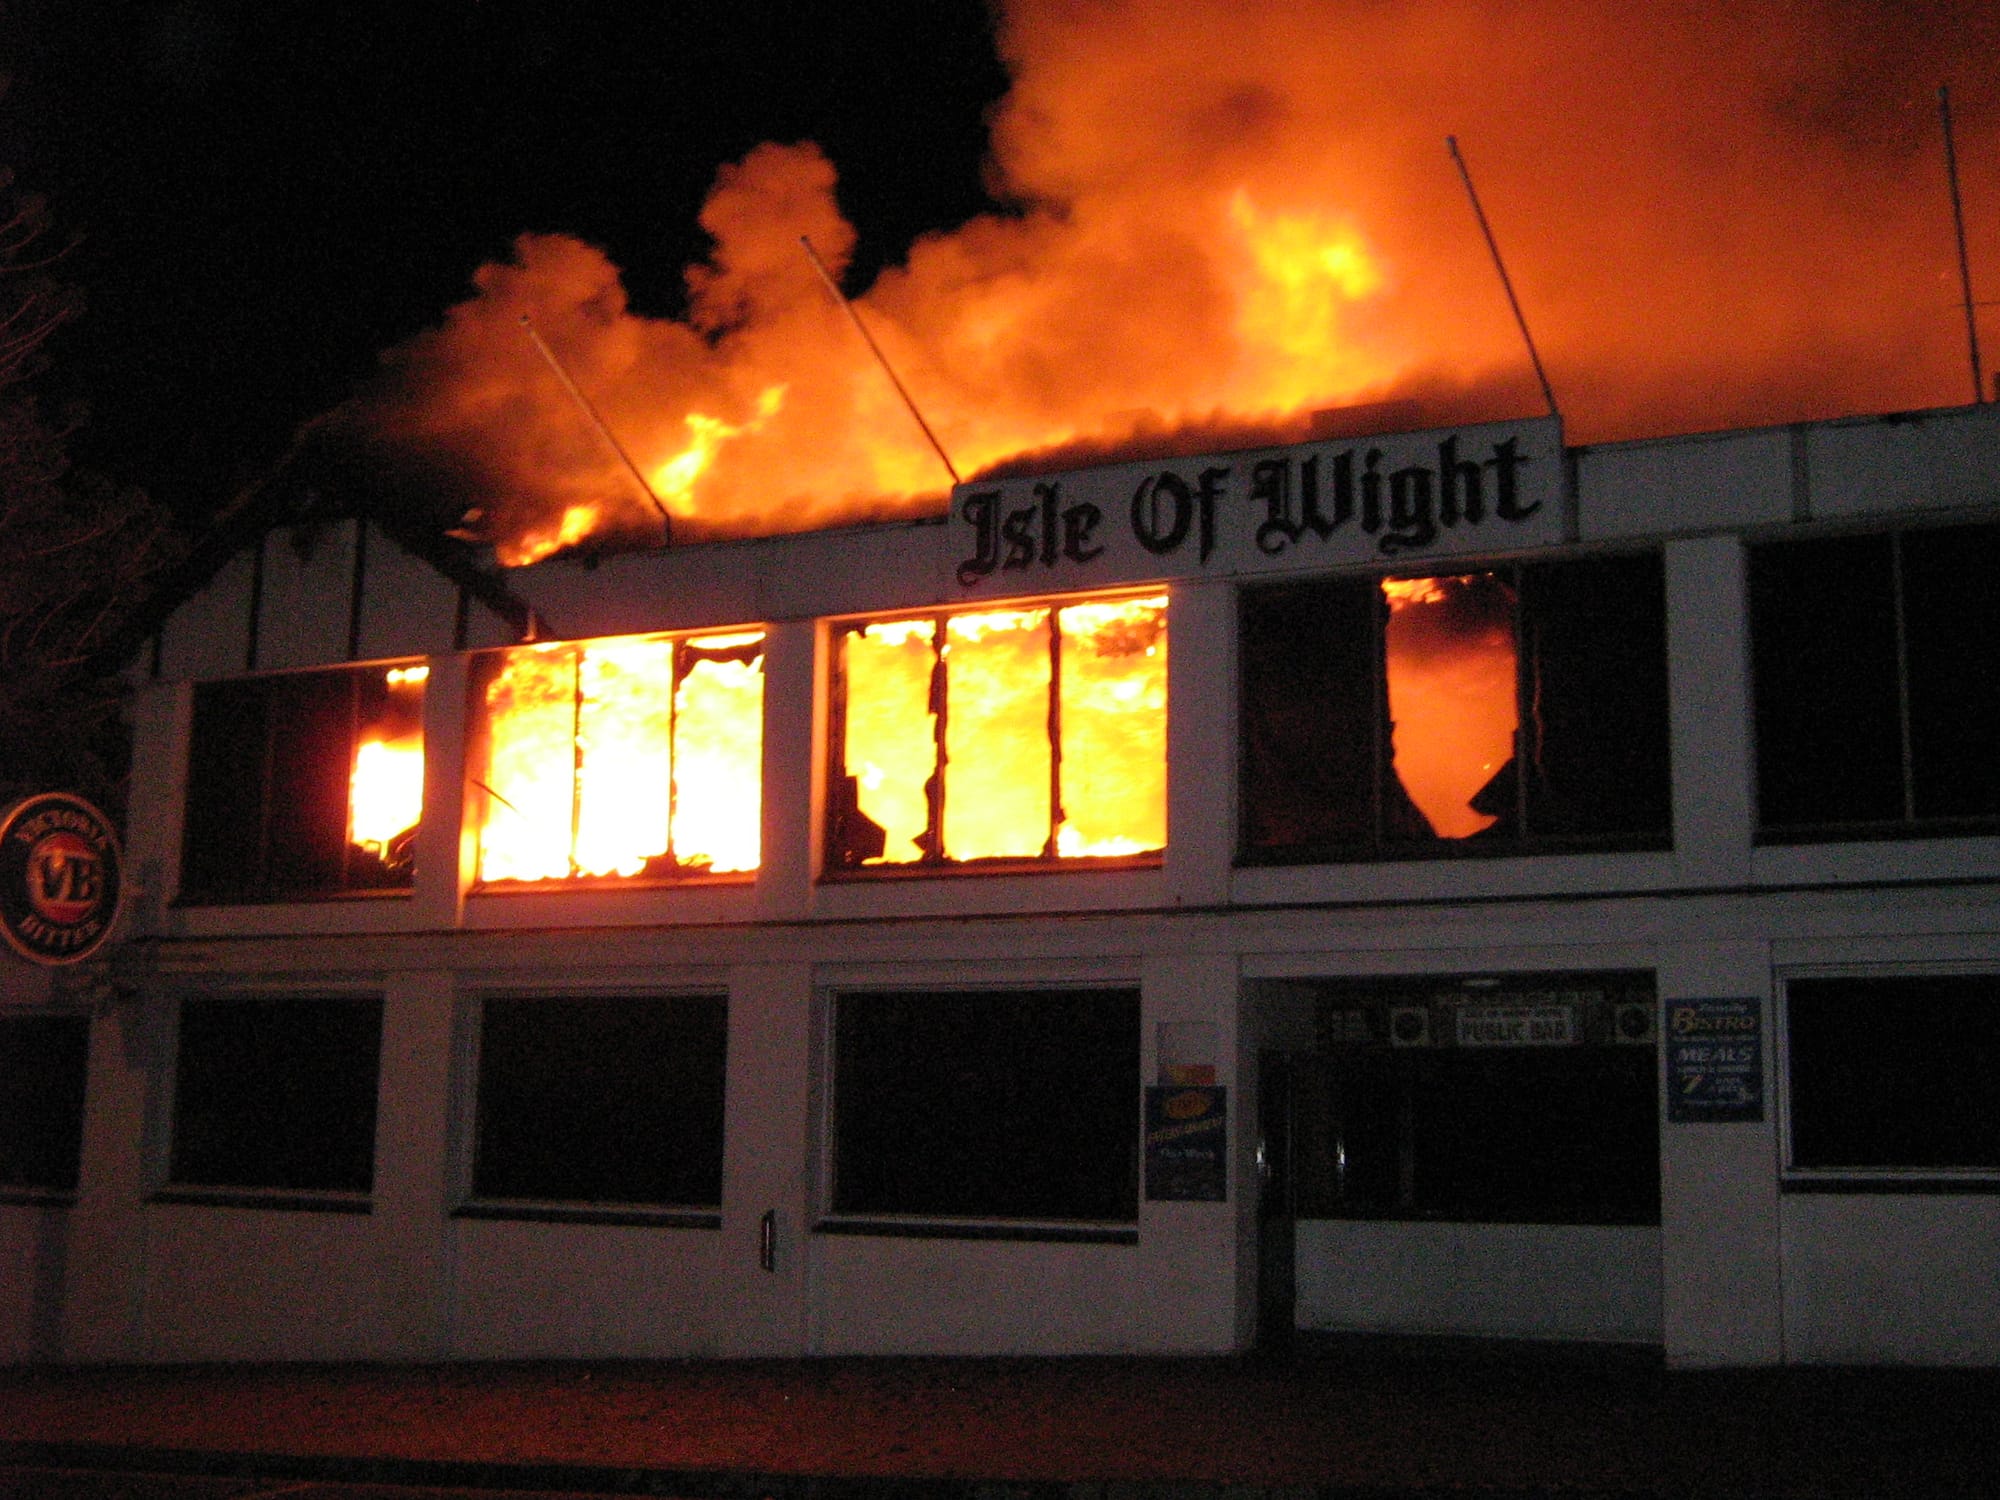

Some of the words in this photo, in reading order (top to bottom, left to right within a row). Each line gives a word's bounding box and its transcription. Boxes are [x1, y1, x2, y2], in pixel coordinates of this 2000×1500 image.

[955, 480, 1103, 587] Isle
[1130, 466, 1235, 564] Of
[1251, 434, 1543, 556] Wight
[1676, 1046, 1754, 1063] MEALS
